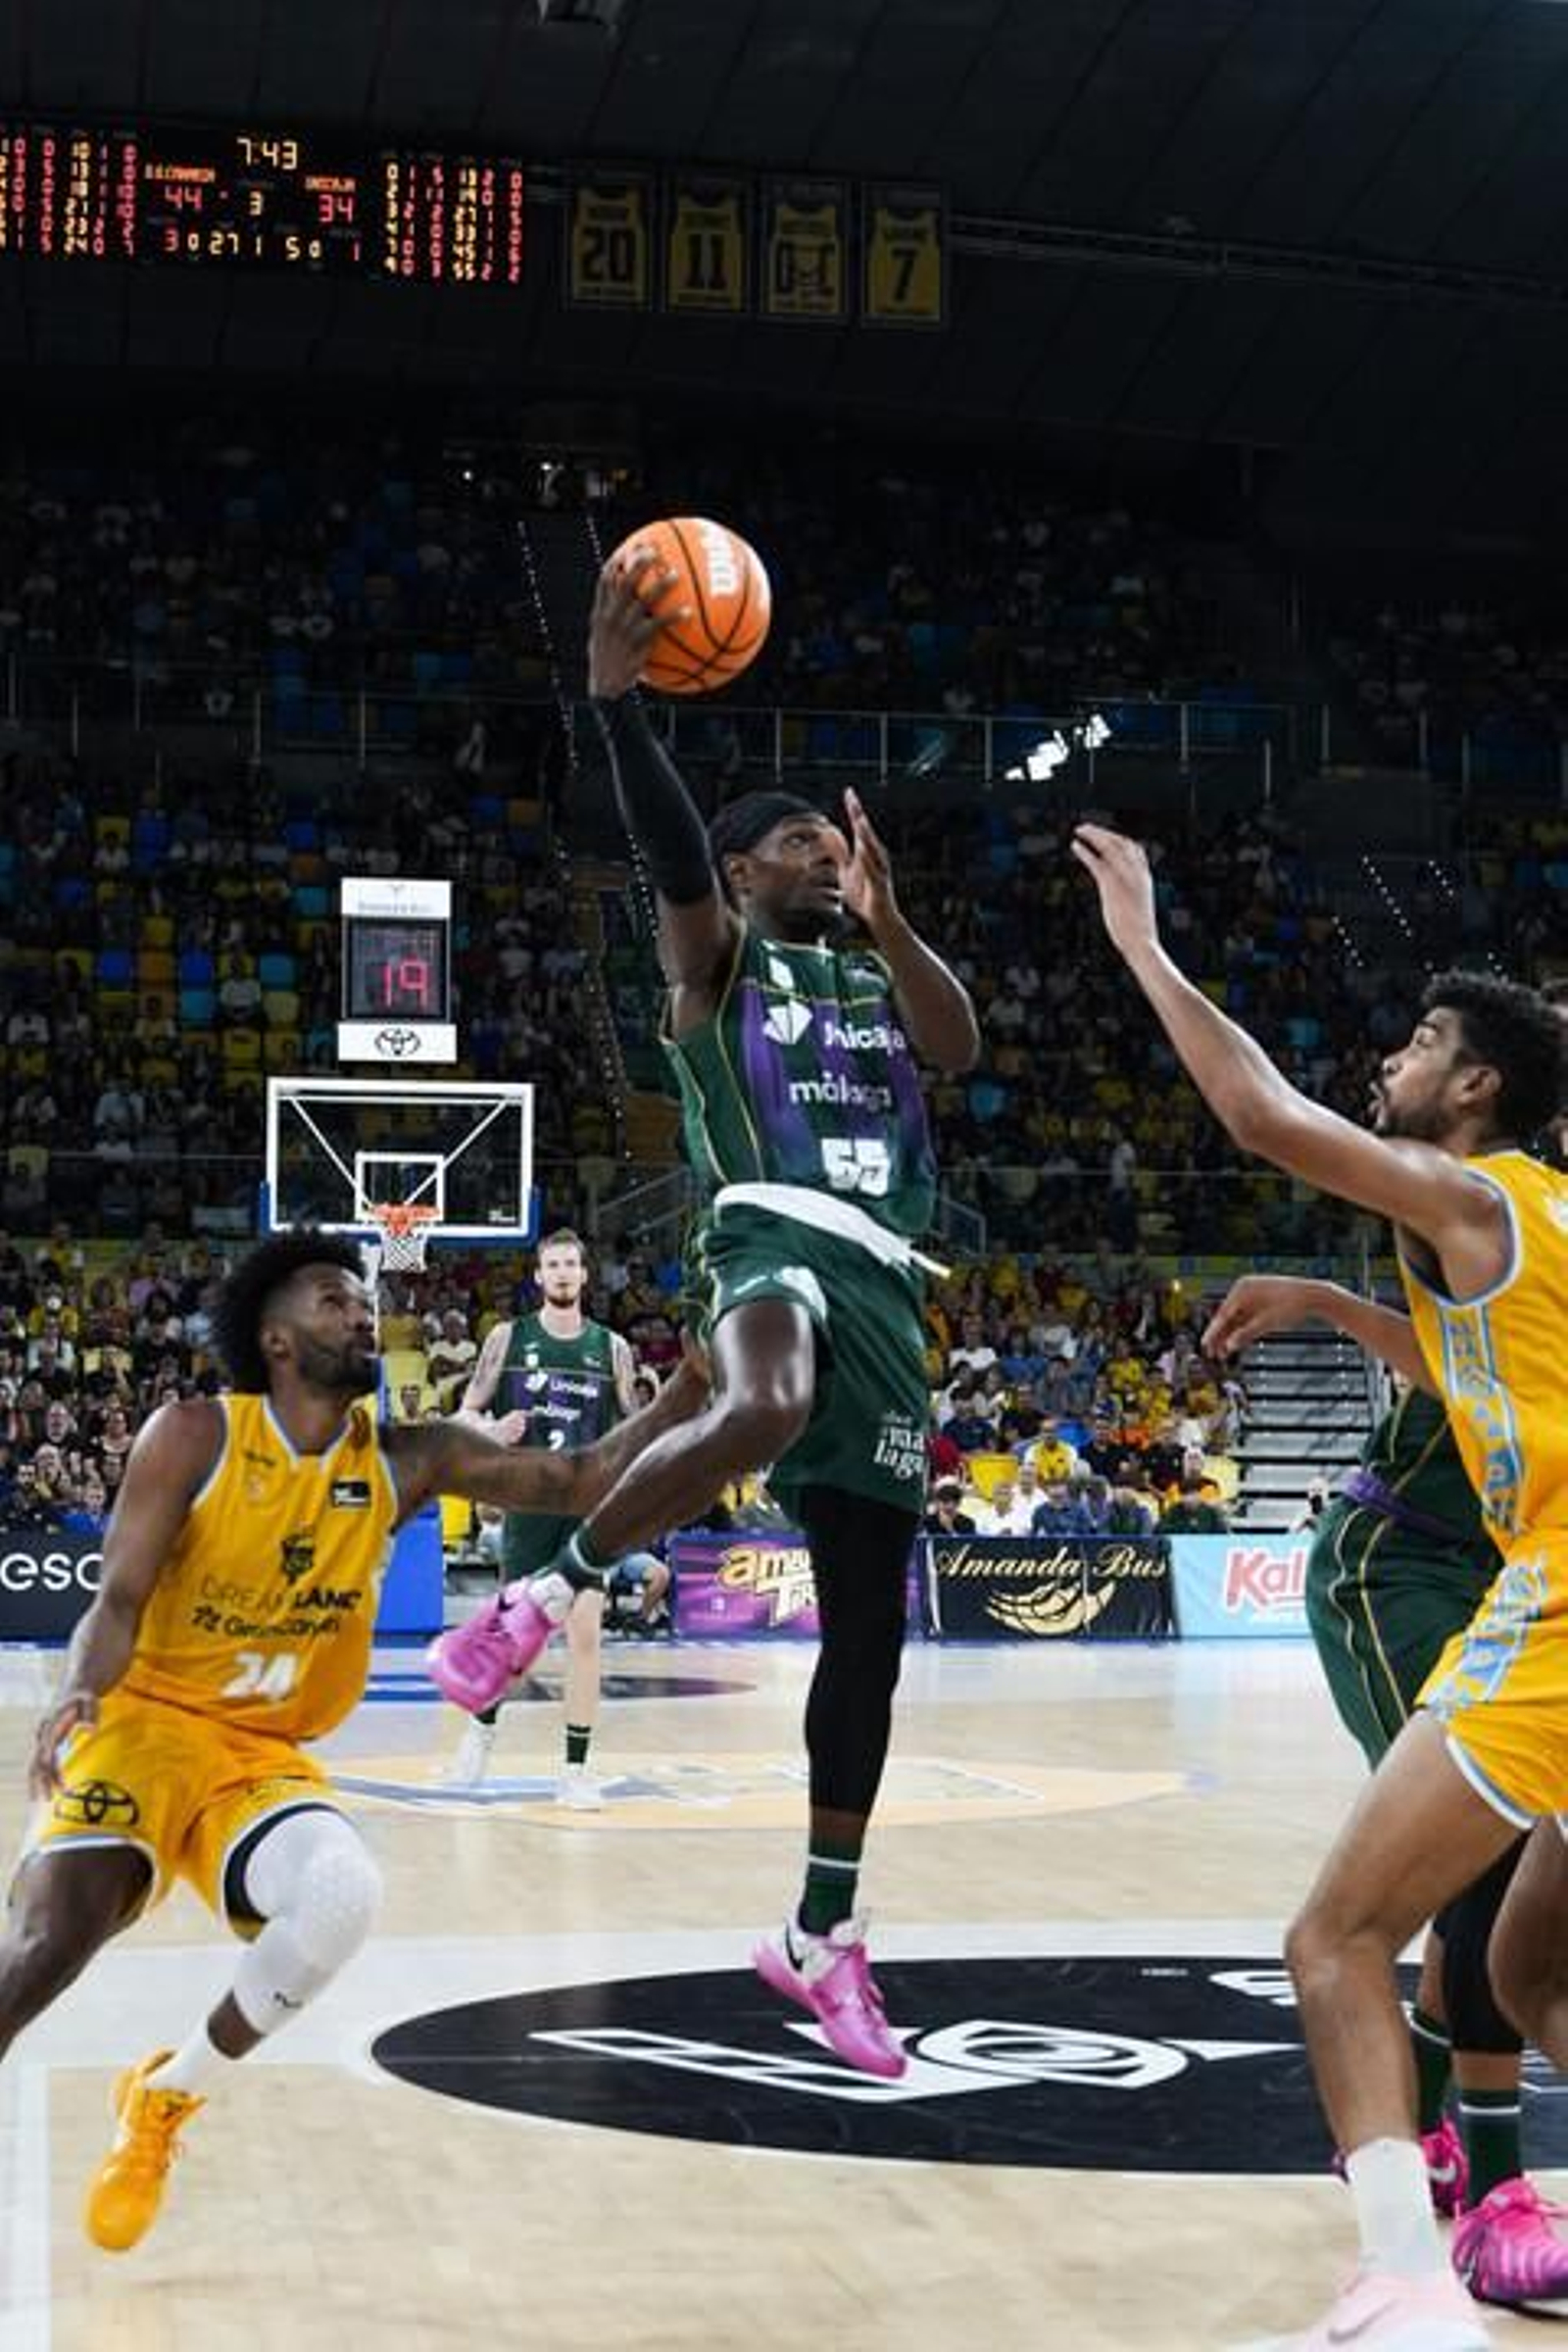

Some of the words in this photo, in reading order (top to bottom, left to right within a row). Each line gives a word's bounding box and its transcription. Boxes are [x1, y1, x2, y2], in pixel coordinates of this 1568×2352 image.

[165, 184, 203, 209] 44
[249, 191, 262, 216] 3
[318, 193, 354, 223] 34
[165, 228, 178, 251] 3
[893, 249, 919, 300] 7
[384, 958, 428, 1008] 19
[937, 1544, 1080, 1579] Amanda
[1092, 1544, 1168, 1579] Bus
[1226, 1551, 1304, 1608] Kal
